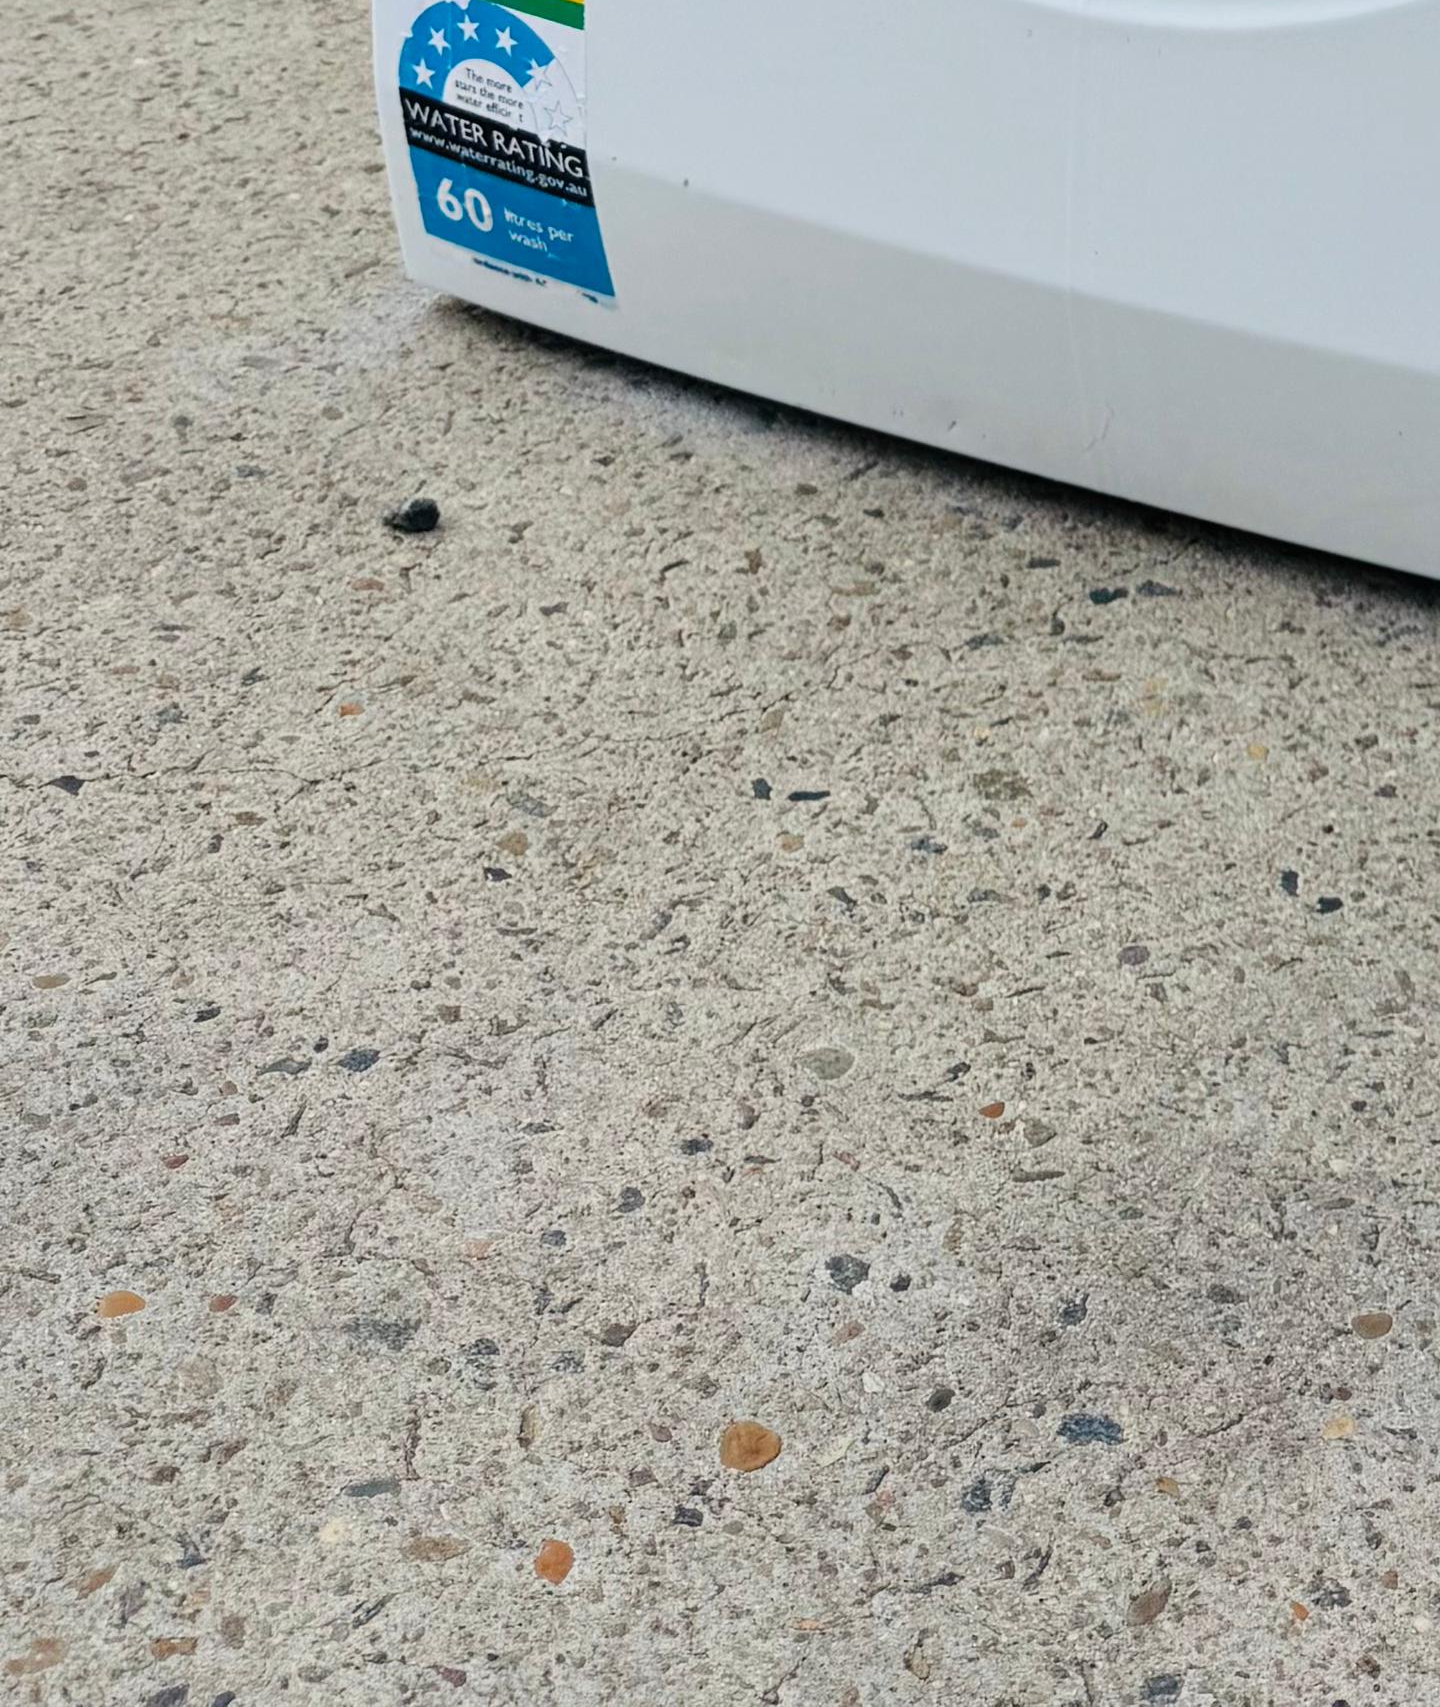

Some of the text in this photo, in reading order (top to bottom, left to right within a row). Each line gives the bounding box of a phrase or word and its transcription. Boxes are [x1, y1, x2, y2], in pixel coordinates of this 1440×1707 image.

[405, 98, 584, 178] WATER RATING
[409, 127, 588, 197] www.waterrating.gov.au
[436, 177, 494, 233] 60
[548, 226, 574, 243] per
[508, 230, 549, 252] wash
